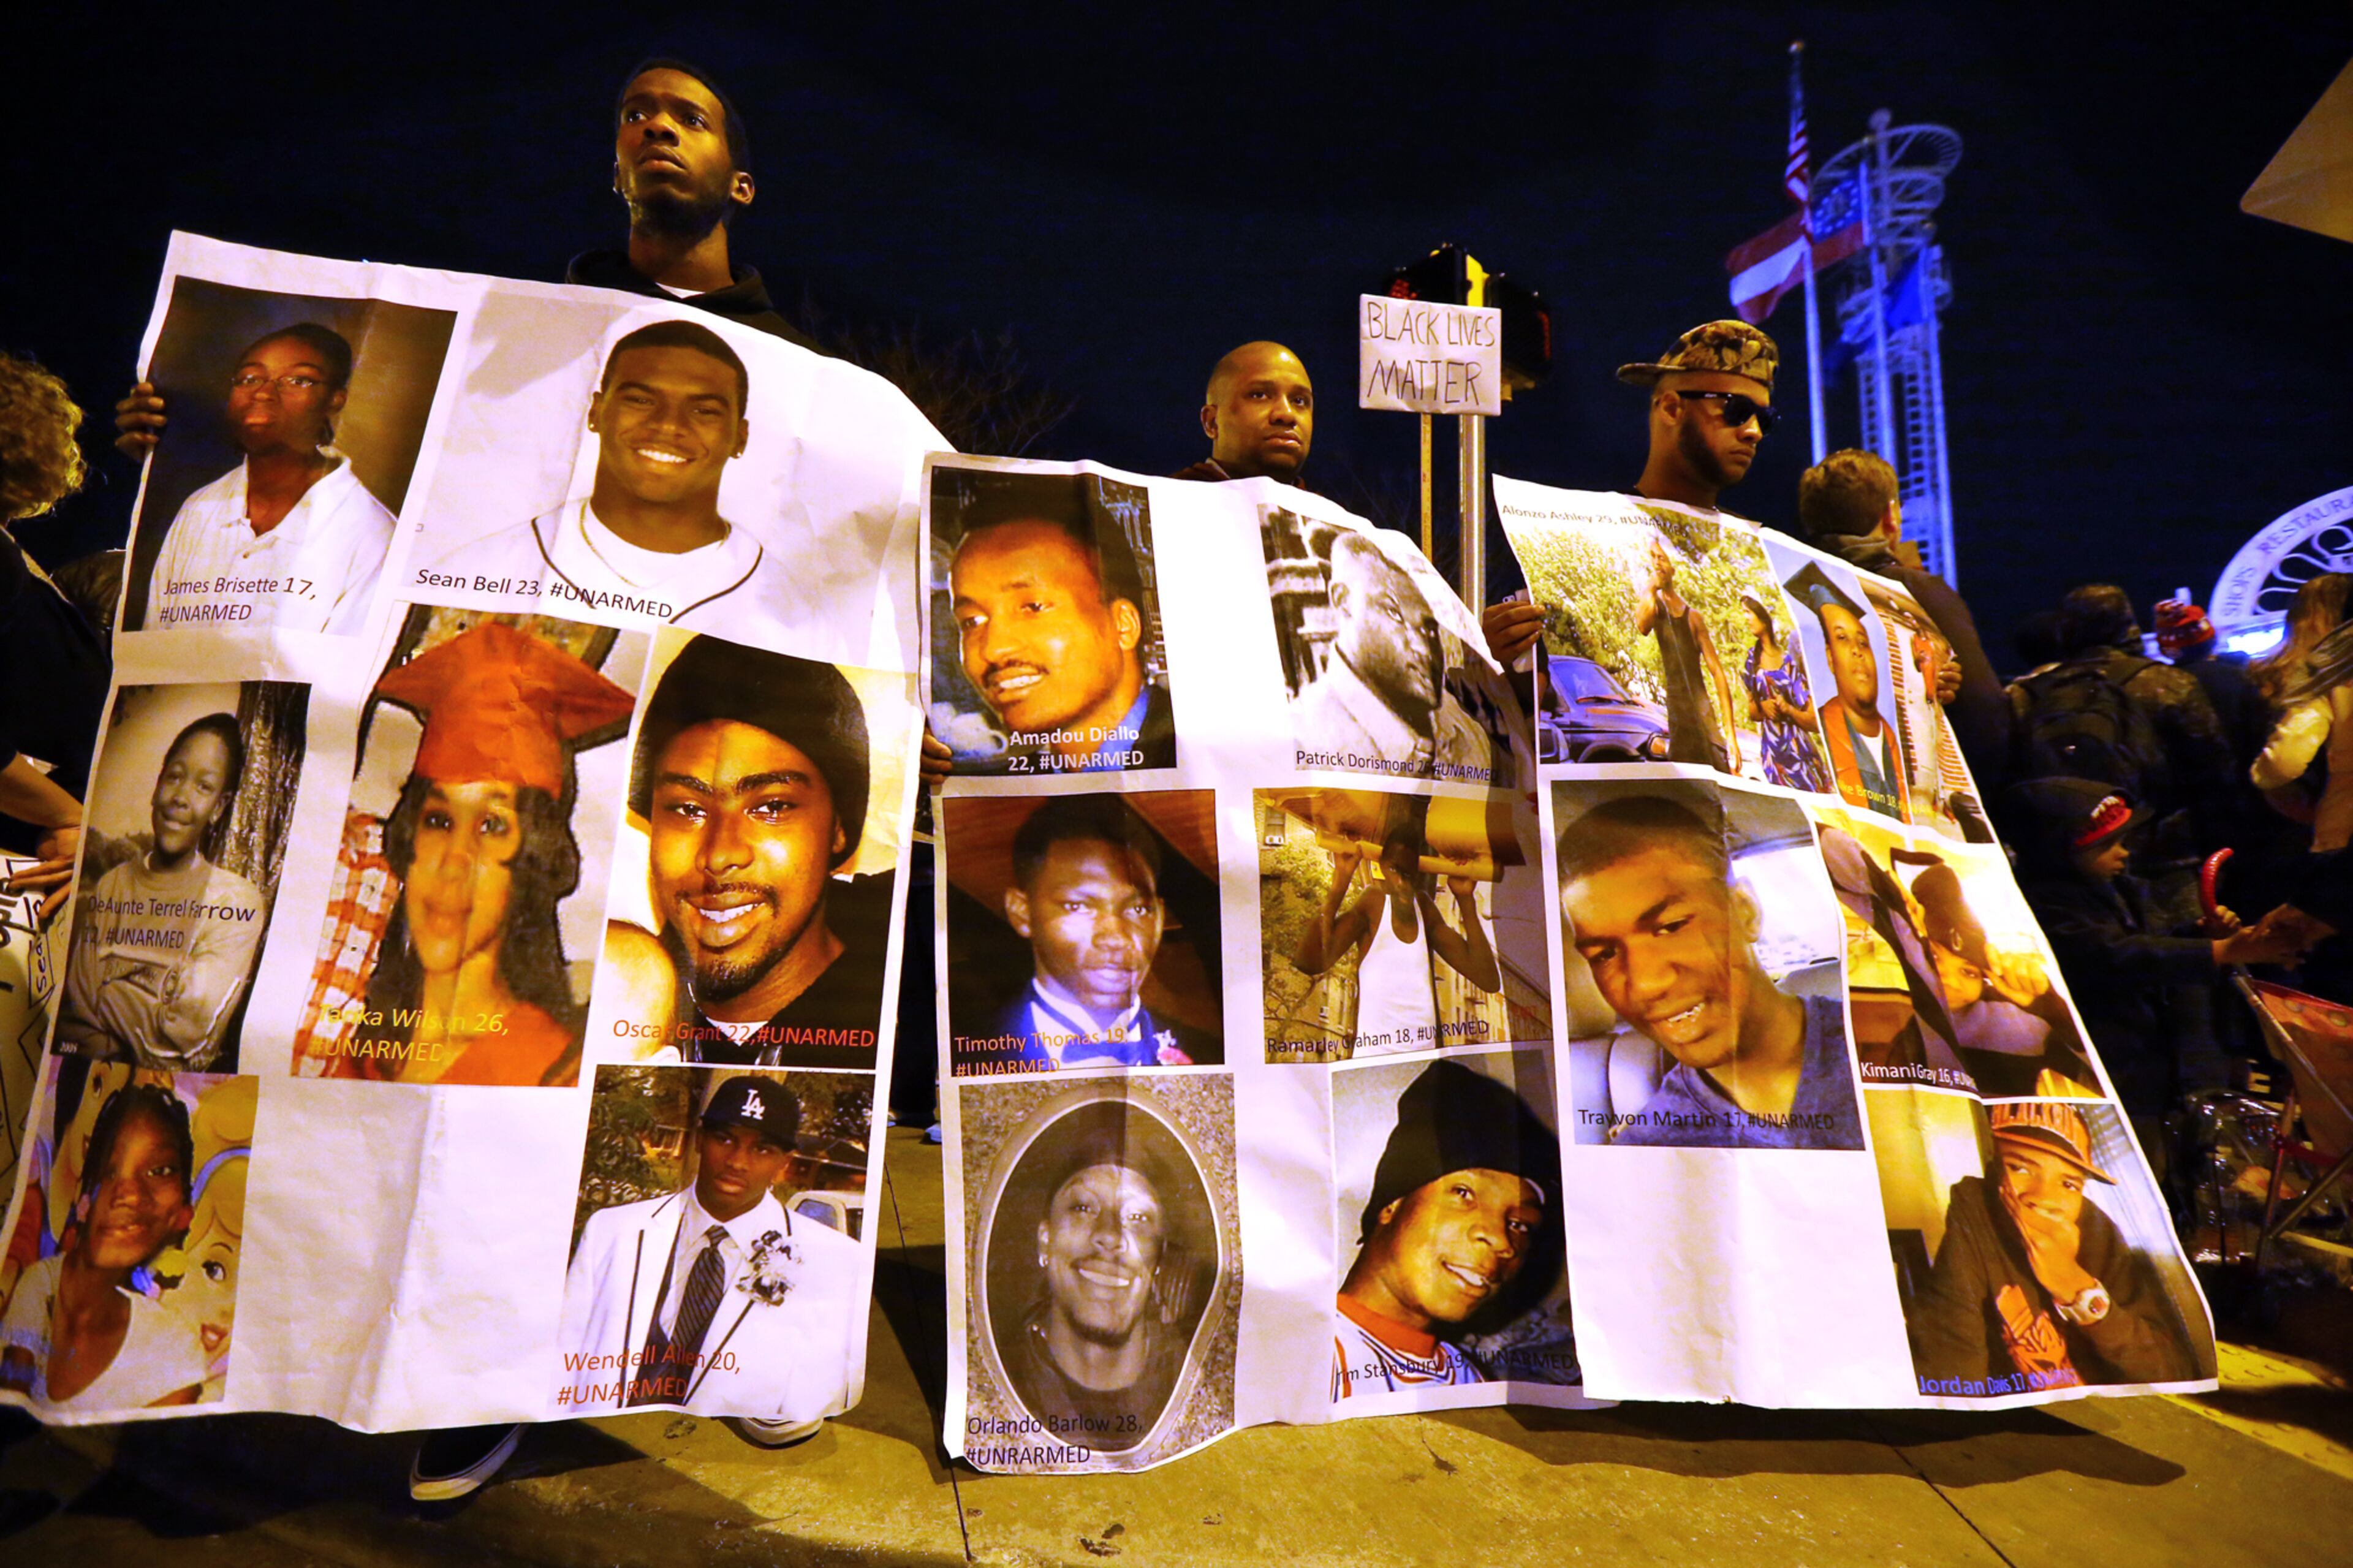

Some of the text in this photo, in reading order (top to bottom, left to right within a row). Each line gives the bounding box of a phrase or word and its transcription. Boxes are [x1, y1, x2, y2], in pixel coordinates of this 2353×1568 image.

[1368, 301, 1495, 347] BLACK LIVES
[1367, 360, 1483, 406] MATTER
[1502, 505, 1546, 518] Alonzo
[1550, 511, 1593, 523] Ashley
[164, 577, 316, 600] James Brisette 17,
[416, 569, 673, 618] Sean Bell 23, #UNARMED
[159, 604, 252, 623] #UNARMED
[1010, 726, 1140, 746] Amadou Diallo
[1008, 751, 1144, 773] 22, #UNARMED
[1296, 750, 1344, 766] Patrick
[1349, 753, 1414, 773] Dorismond
[88, 895, 144, 915] DeAunte
[190, 901, 256, 922] Farrow
[106, 928, 184, 949] #UNARMED
[392, 1008, 465, 1031] Wilson
[474, 1013, 509, 1036] 26,
[613, 1019, 671, 1038] Oscar
[675, 1022, 722, 1041] Grant
[955, 1034, 1026, 1053] Timothy
[1031, 1031, 1099, 1048] Thomas
[1268, 1037, 1339, 1053] Ramarley
[1395, 1028, 1414, 1045] 18,
[1417, 1020, 1490, 1041] #UNRMED
[956, 1058, 1060, 1078] #UNARMED
[1860, 1062, 1916, 1078] Kimani
[1917, 1064, 1937, 1084] Gray
[741, 1088, 765, 1120] LA
[1578, 1110, 1648, 1127] Trayvon
[1654, 1110, 1716, 1127] Martin
[564, 1345, 740, 1374] Wendell Allen 20,
[1364, 1355, 1441, 1379] Stansbury
[557, 1376, 688, 1405] #UNARMED
[1920, 1375, 1985, 1395] Jordan
[968, 1414, 1143, 1435] Orlando Barlow 28,
[966, 1444, 1090, 1466] #UNRARMED
